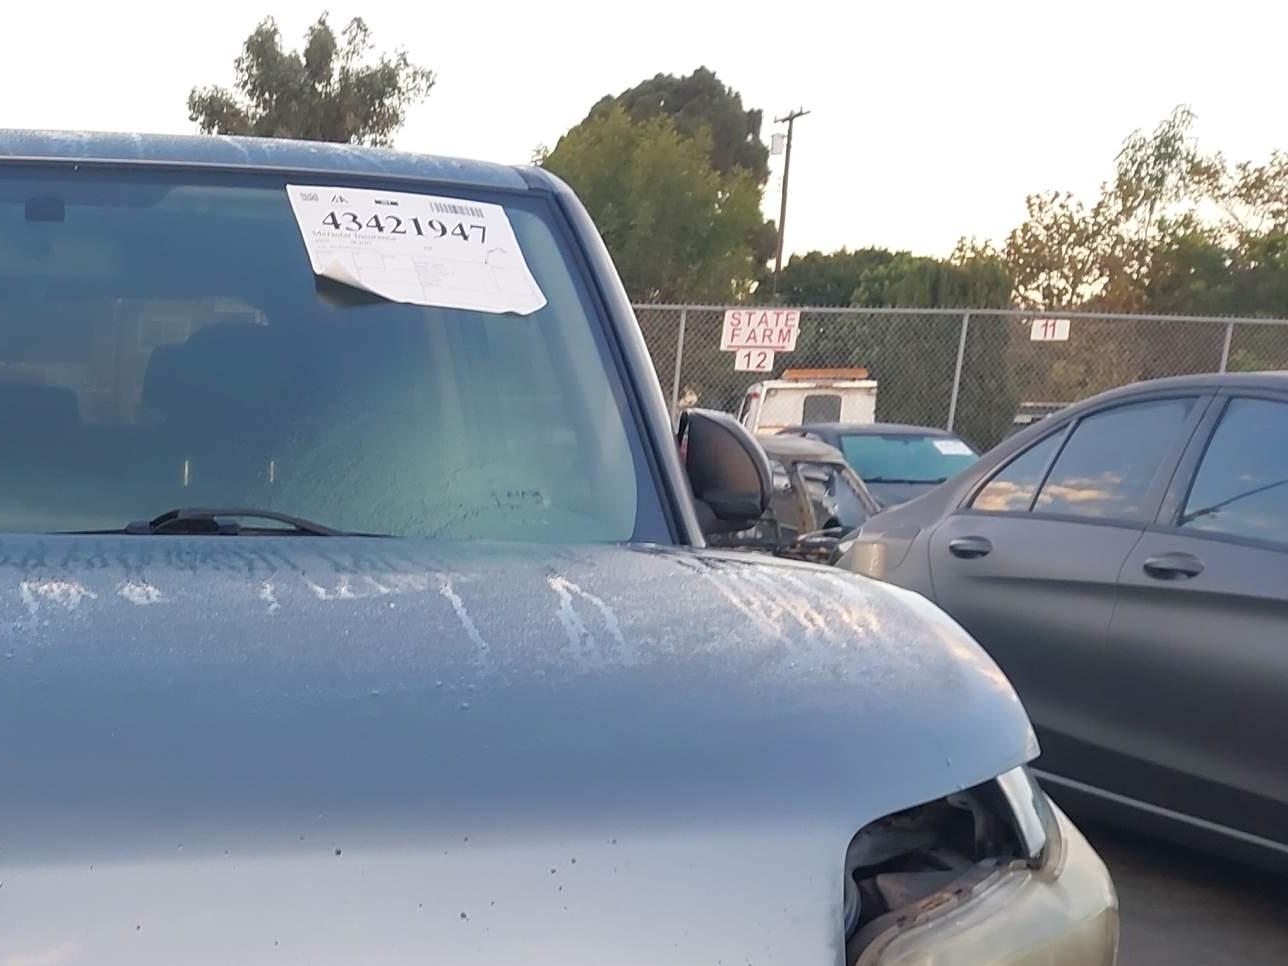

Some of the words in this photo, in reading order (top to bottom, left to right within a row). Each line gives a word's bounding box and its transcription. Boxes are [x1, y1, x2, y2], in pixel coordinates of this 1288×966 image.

[322, 210, 487, 244] 43421947
[730, 311, 797, 328] STATE
[1041, 319, 1057, 339] 11
[730, 328, 791, 344] FARM
[743, 350, 768, 369] 12
